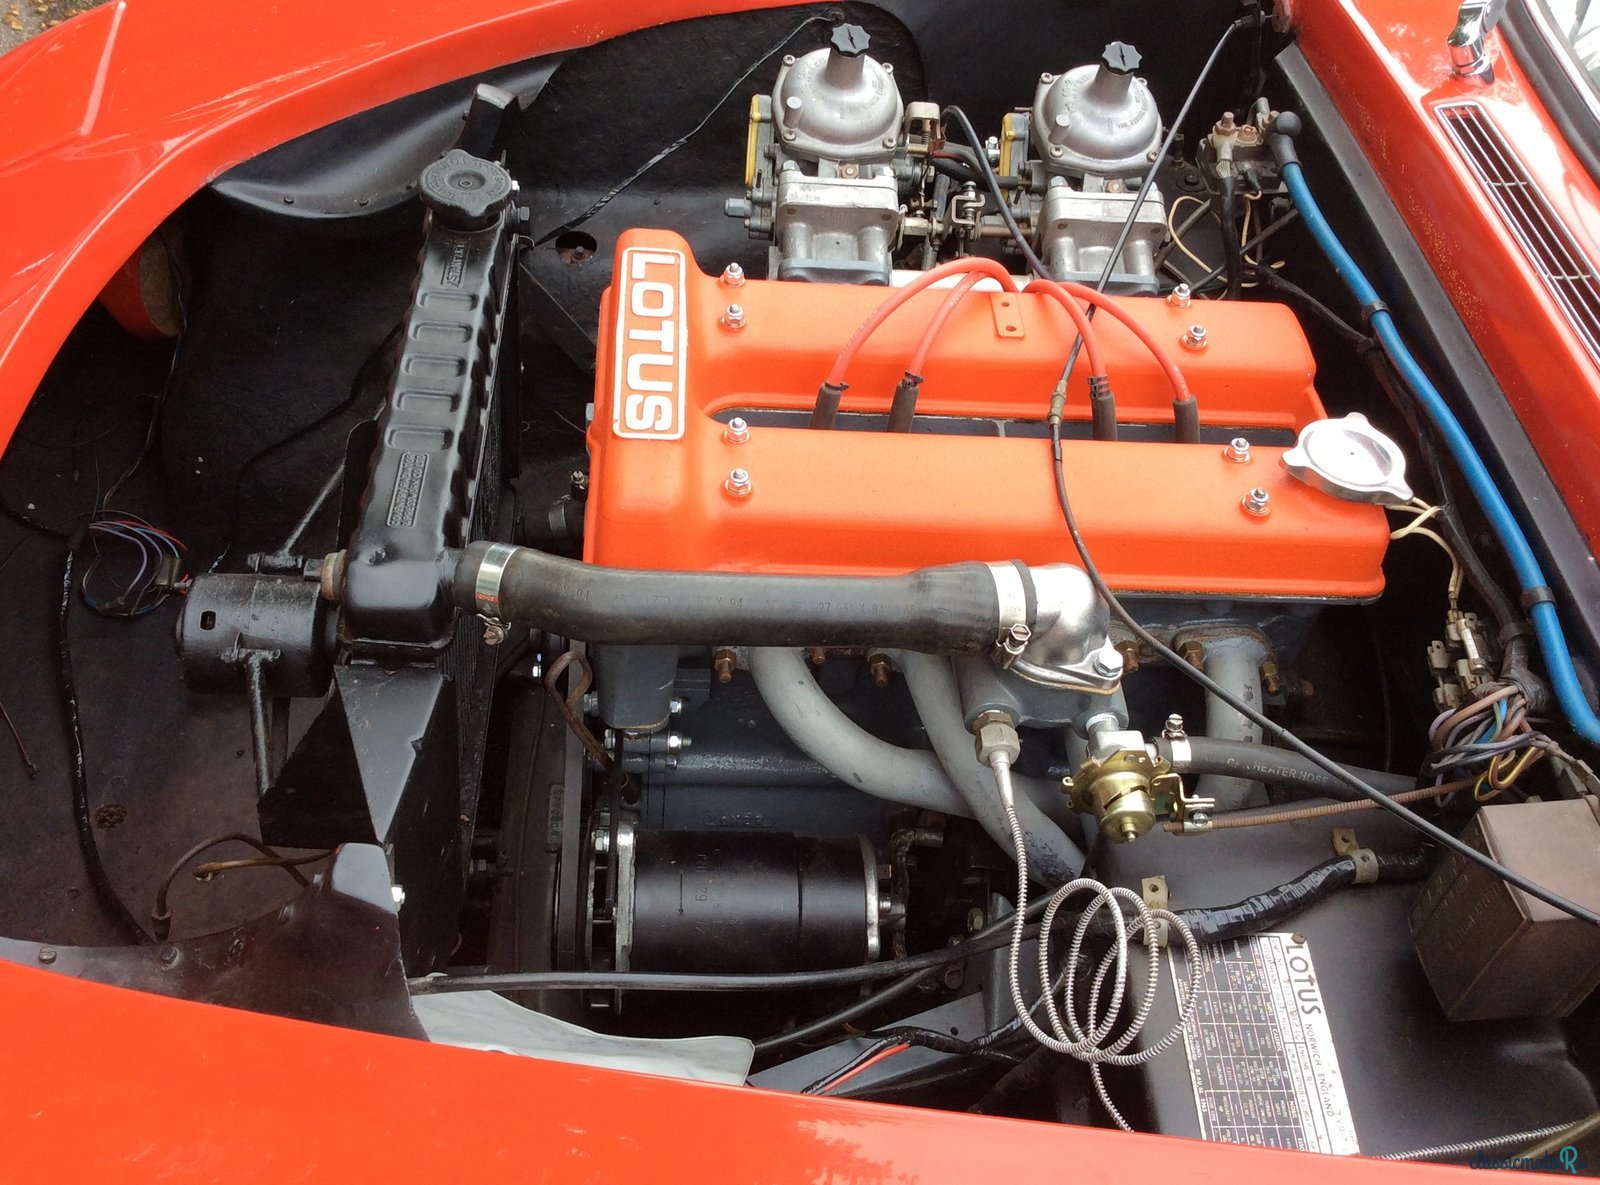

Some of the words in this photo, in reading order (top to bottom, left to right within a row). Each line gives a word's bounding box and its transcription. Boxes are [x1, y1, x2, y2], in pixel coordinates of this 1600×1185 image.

[625, 253, 675, 431] LOTUS
[1253, 761, 1297, 779] HEATER
[1299, 770, 1330, 786] HOSE
[1284, 944, 1322, 1015] LOTUS
[1271, 1027, 1283, 1052] CASTROL
[1304, 1023, 1322, 1066] NORWICH
[1317, 1073, 1336, 1117] ENGLAND
